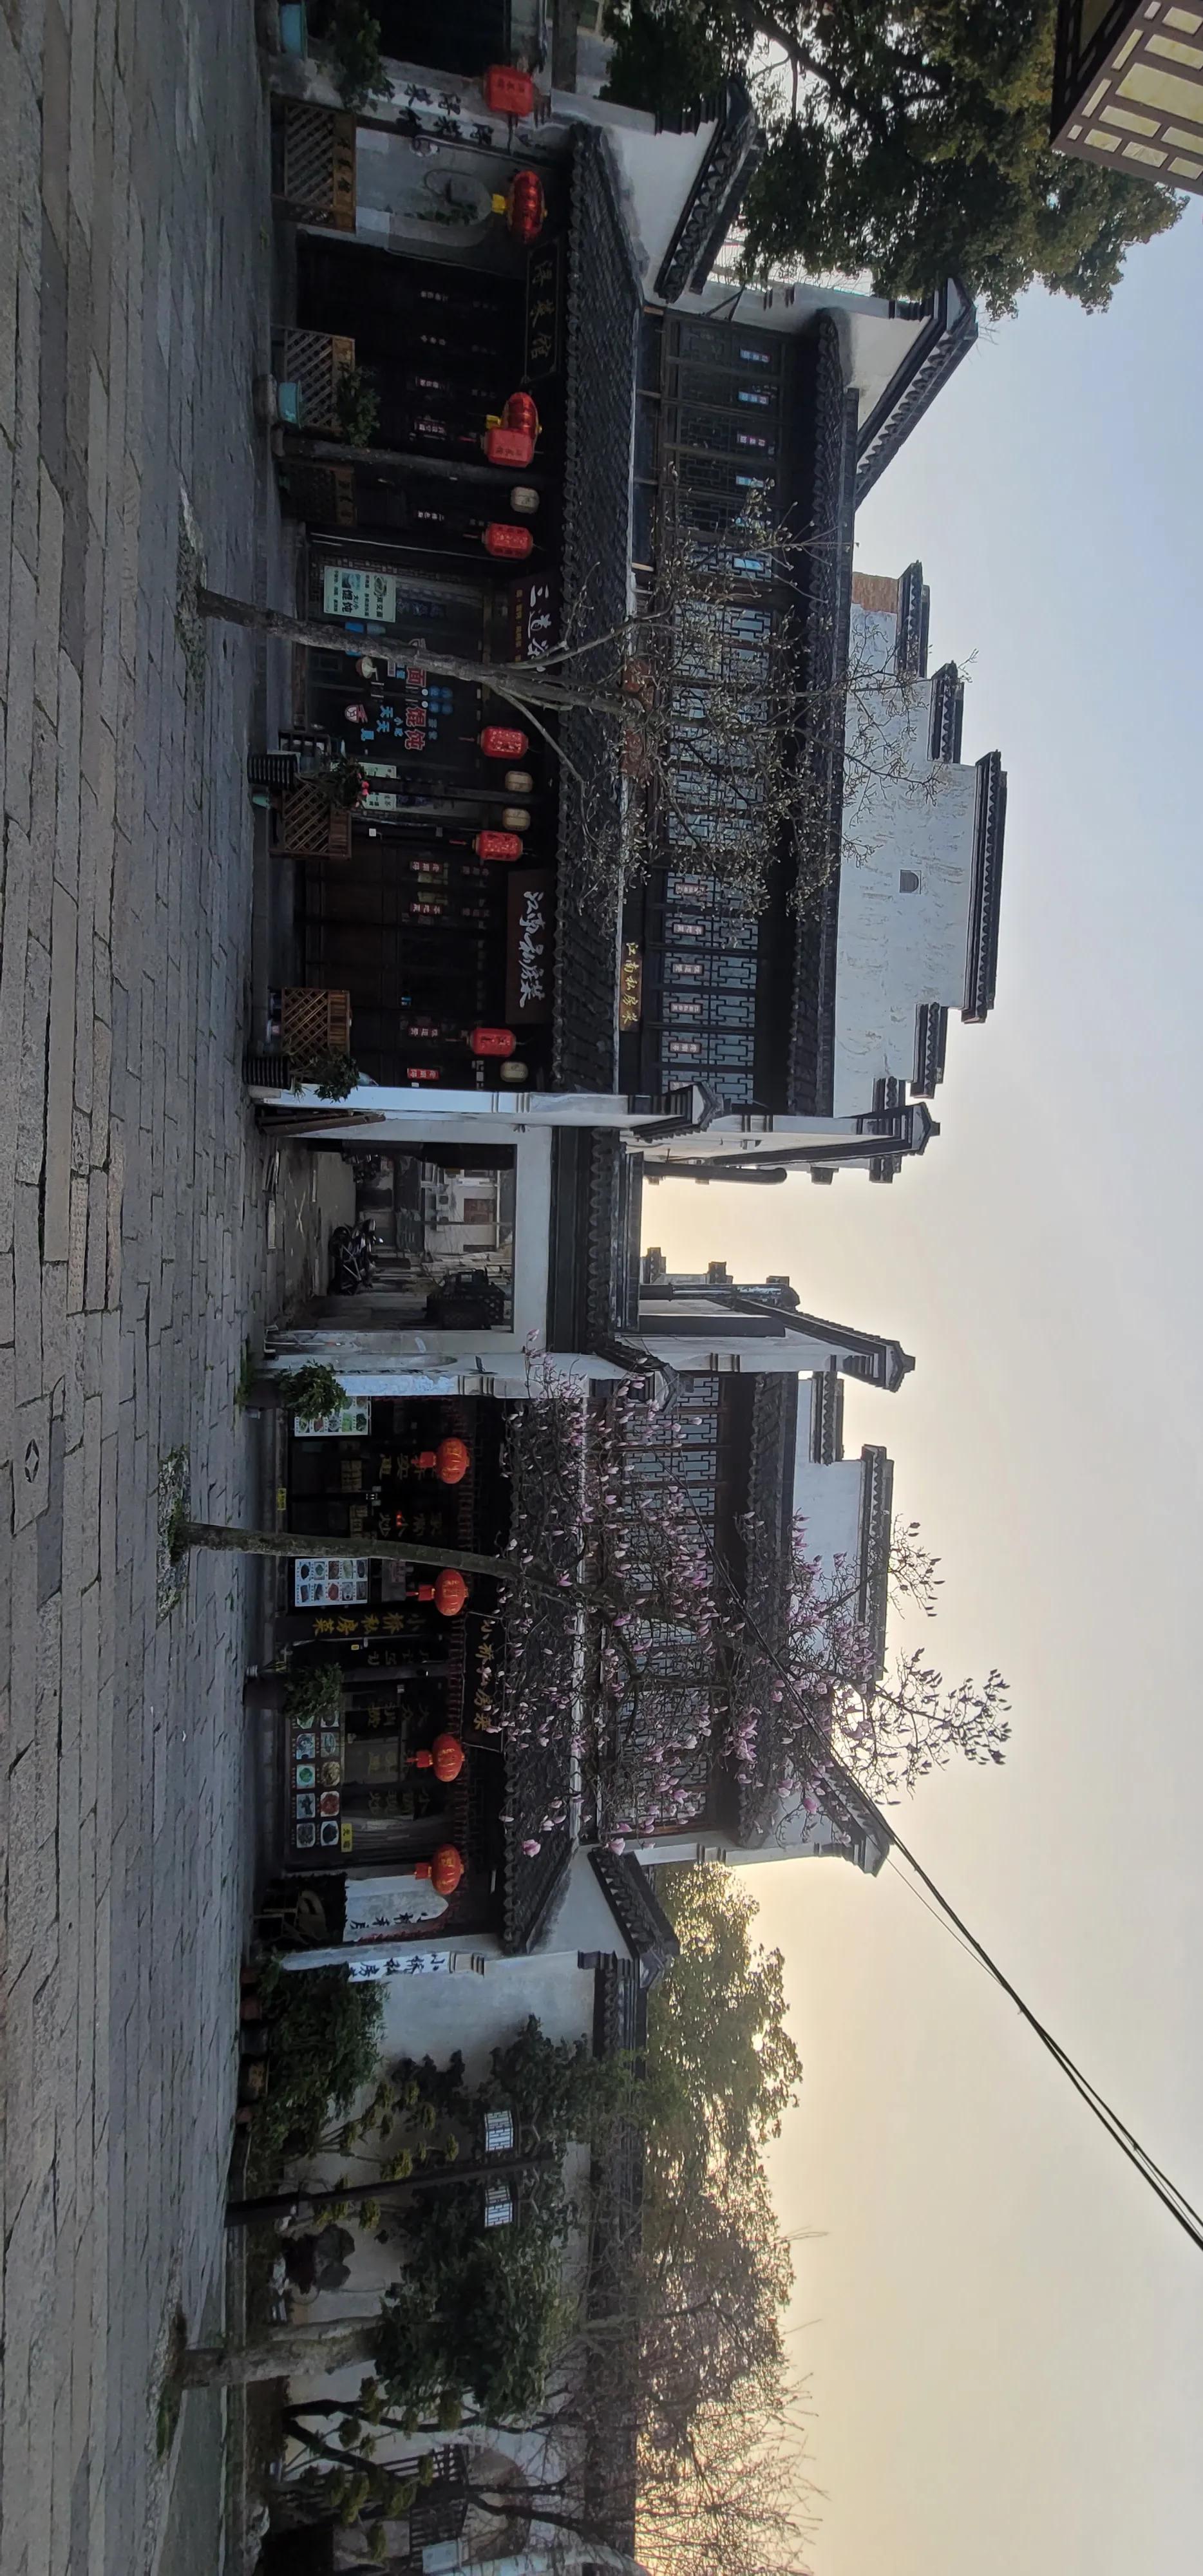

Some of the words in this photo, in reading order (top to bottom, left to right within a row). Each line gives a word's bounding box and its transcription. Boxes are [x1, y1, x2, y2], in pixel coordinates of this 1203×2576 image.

[342, 590, 353, 613] 馄饨
[406, 668, 427, 688] 面
[404, 707, 427, 751] 馄饨
[518, 891, 546, 1009] 江南私房菜
[622, 942, 639, 1025] 江南私房菜
[312, 1612, 427, 1636] 小桥私房菜
